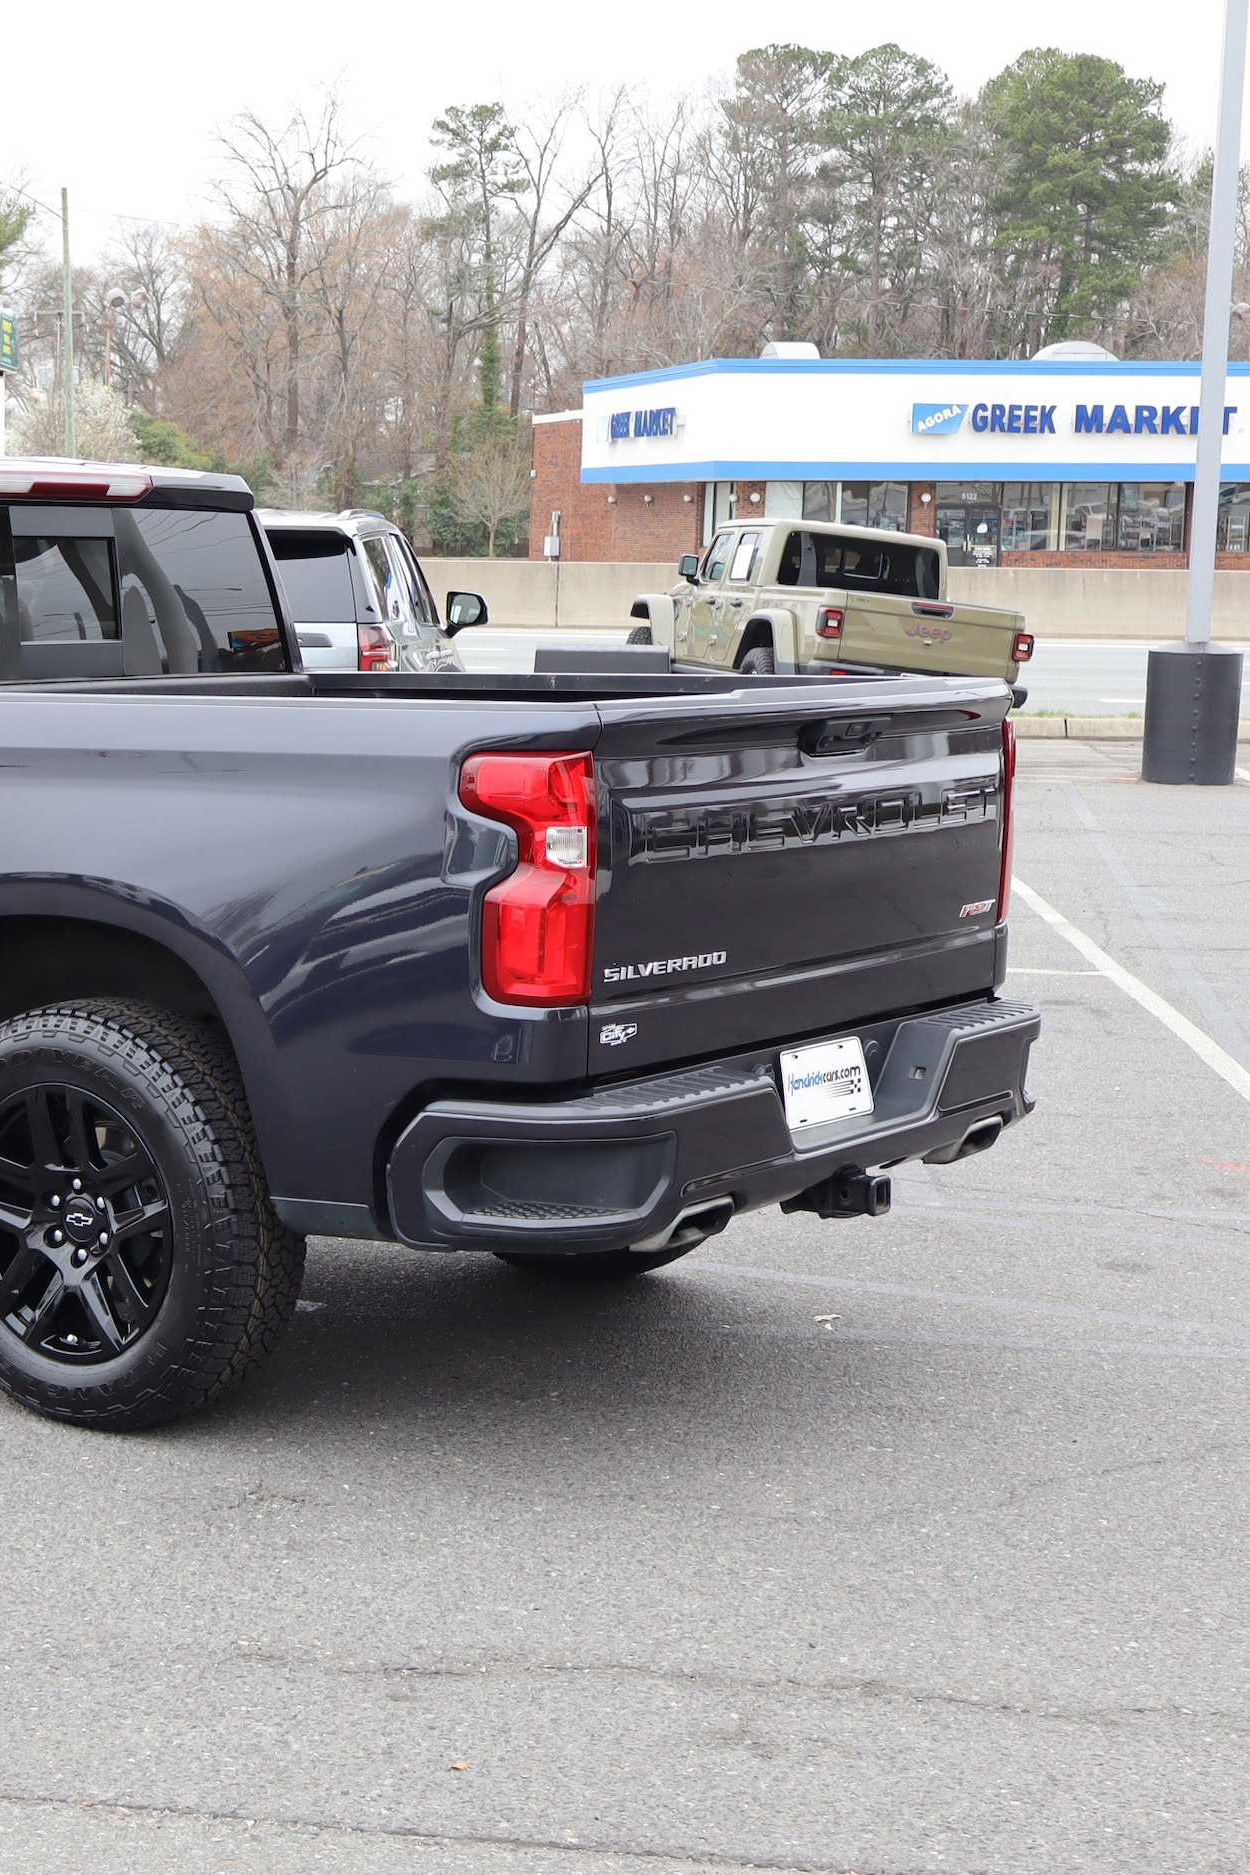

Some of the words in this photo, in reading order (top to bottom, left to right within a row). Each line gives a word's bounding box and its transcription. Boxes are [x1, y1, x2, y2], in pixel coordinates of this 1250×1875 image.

[611, 411, 631, 439] GREEK
[634, 407, 676, 437] MARKET
[917, 405, 962, 432] AGORA
[972, 403, 1058, 434] GREEK
[1075, 405, 1238, 435] MARKT
[905, 620, 954, 644] Jeep
[645, 786, 996, 863] CHEVROLET
[959, 898, 996, 917] RST
[603, 950, 727, 982] SILVERADO
